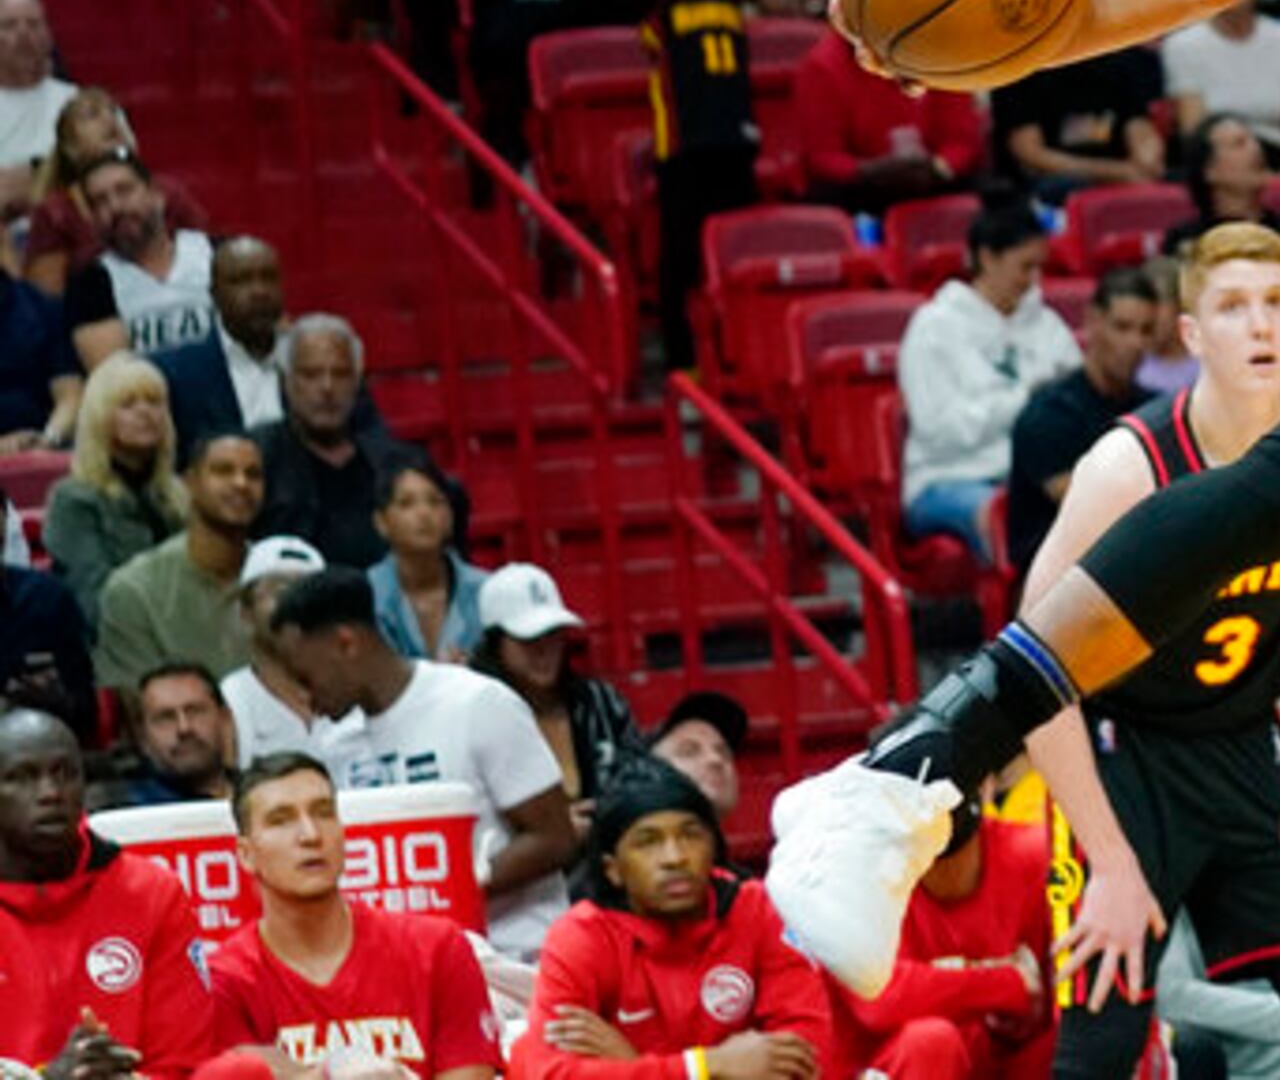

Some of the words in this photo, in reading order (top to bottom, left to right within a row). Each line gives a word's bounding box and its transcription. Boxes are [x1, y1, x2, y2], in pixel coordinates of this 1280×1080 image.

[702, 32, 737, 75] 11
[1194, 614, 1261, 686] 3
[150, 850, 240, 900] IO
[338, 829, 449, 889] BIO
[273, 1017, 426, 1067] ATLANTA
